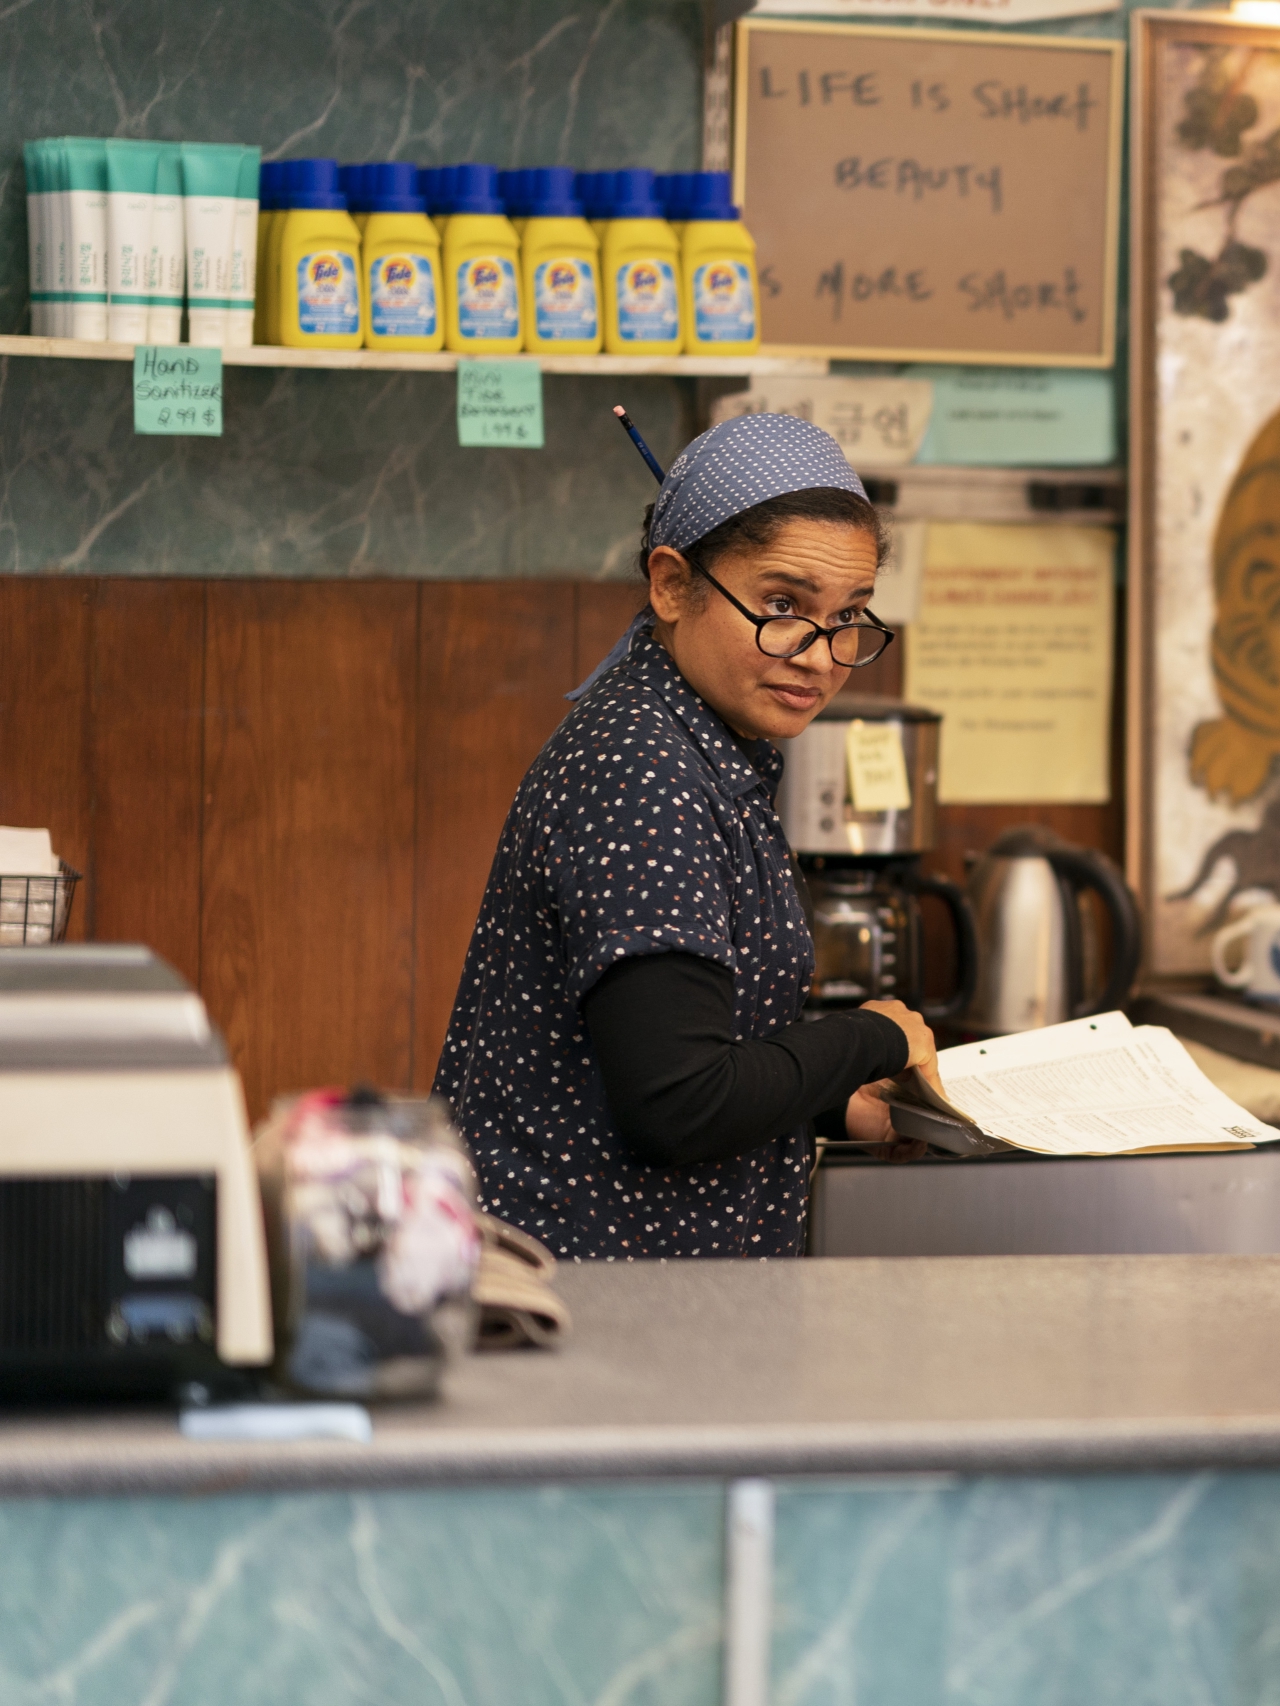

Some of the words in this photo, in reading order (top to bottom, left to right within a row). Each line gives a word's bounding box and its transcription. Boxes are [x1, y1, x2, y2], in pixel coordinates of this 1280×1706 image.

[760, 67, 882, 107] LIFE
[910, 80, 951, 113] IS
[313, 264, 339, 281] Tide
[387, 266, 412, 284] Tide
[815, 261, 932, 321] MORE
